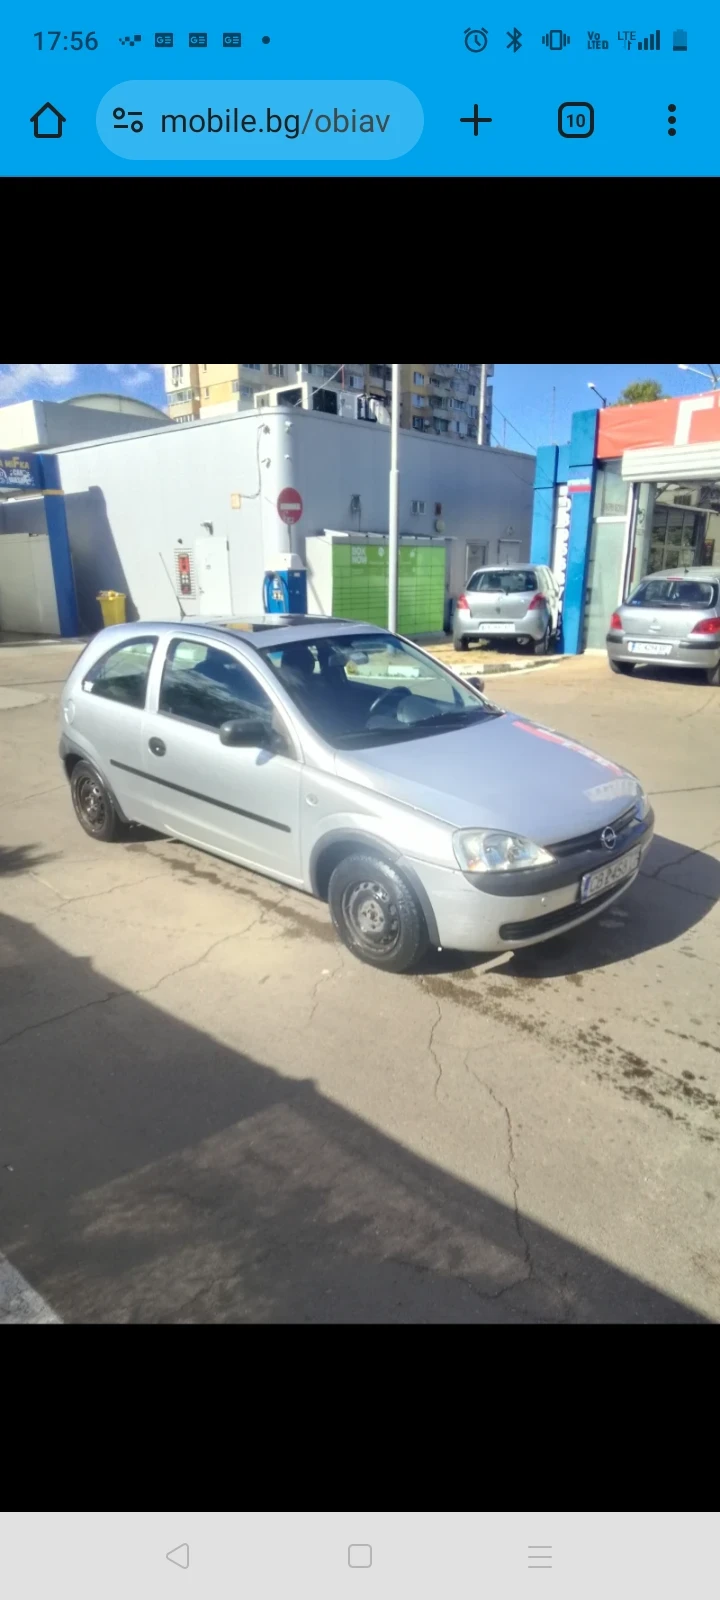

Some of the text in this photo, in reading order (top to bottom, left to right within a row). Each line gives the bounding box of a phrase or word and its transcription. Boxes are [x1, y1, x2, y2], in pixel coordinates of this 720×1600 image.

[34, 31, 98, 50] 17:56
[618, 31, 637, 40] LTE
[161, 107, 391, 139] mobile.bg/obiav
[567, 114, 586, 127] 10
[352, 545, 367, 555] BOX
[352, 555, 368, 565] NOW
